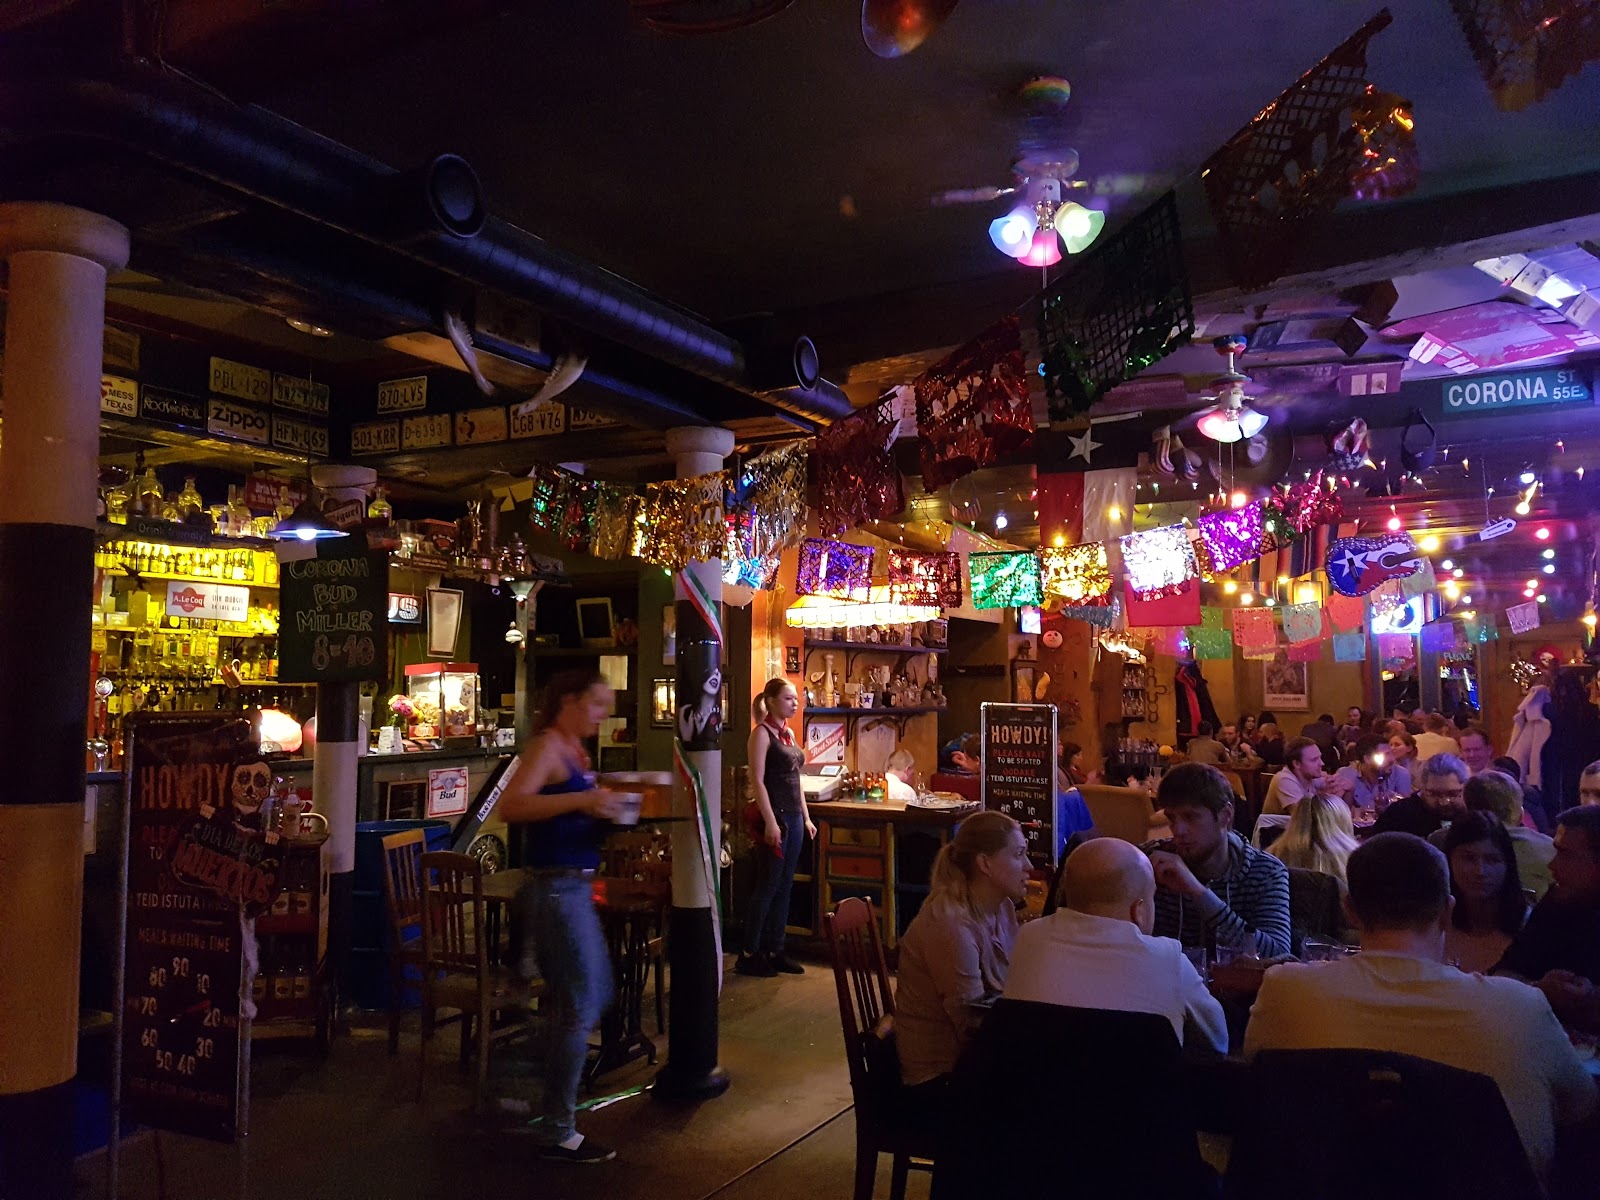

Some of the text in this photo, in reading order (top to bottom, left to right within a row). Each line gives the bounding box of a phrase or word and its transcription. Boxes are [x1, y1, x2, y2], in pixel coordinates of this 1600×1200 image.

[1557, 370, 1575, 383] ST
[108, 388, 134, 401] MESS
[1449, 376, 1548, 407] CORONA
[105, 398, 133, 412] TEXAS
[144, 398, 169, 413] ROCK
[181, 406, 203, 420] ROLL
[289, 557, 369, 579] CORONA
[190, 596, 203, 606] Coq
[313, 583, 358, 606] BUD
[312, 633, 375, 671] 8-10
[991, 724, 1048, 746] HOWDY!
[997, 756, 1042, 766] TO BE SEATED
[439, 789, 457, 801] Bud
[1013, 799, 1025, 810] 90
[1026, 806, 1036, 816] 10
[1028, 831, 1039, 842] 30
[149, 846, 163, 861] TO
[149, 966, 167, 988] 80
[172, 956, 190, 978] 90
[196, 973, 211, 995] 10
[141, 995, 159, 1017] 70
[202, 1007, 221, 1028] 20
[141, 1027, 159, 1048] 60
[196, 1036, 215, 1060] 30
[155, 1049, 174, 1072] 50
[177, 1053, 197, 1076] 40
